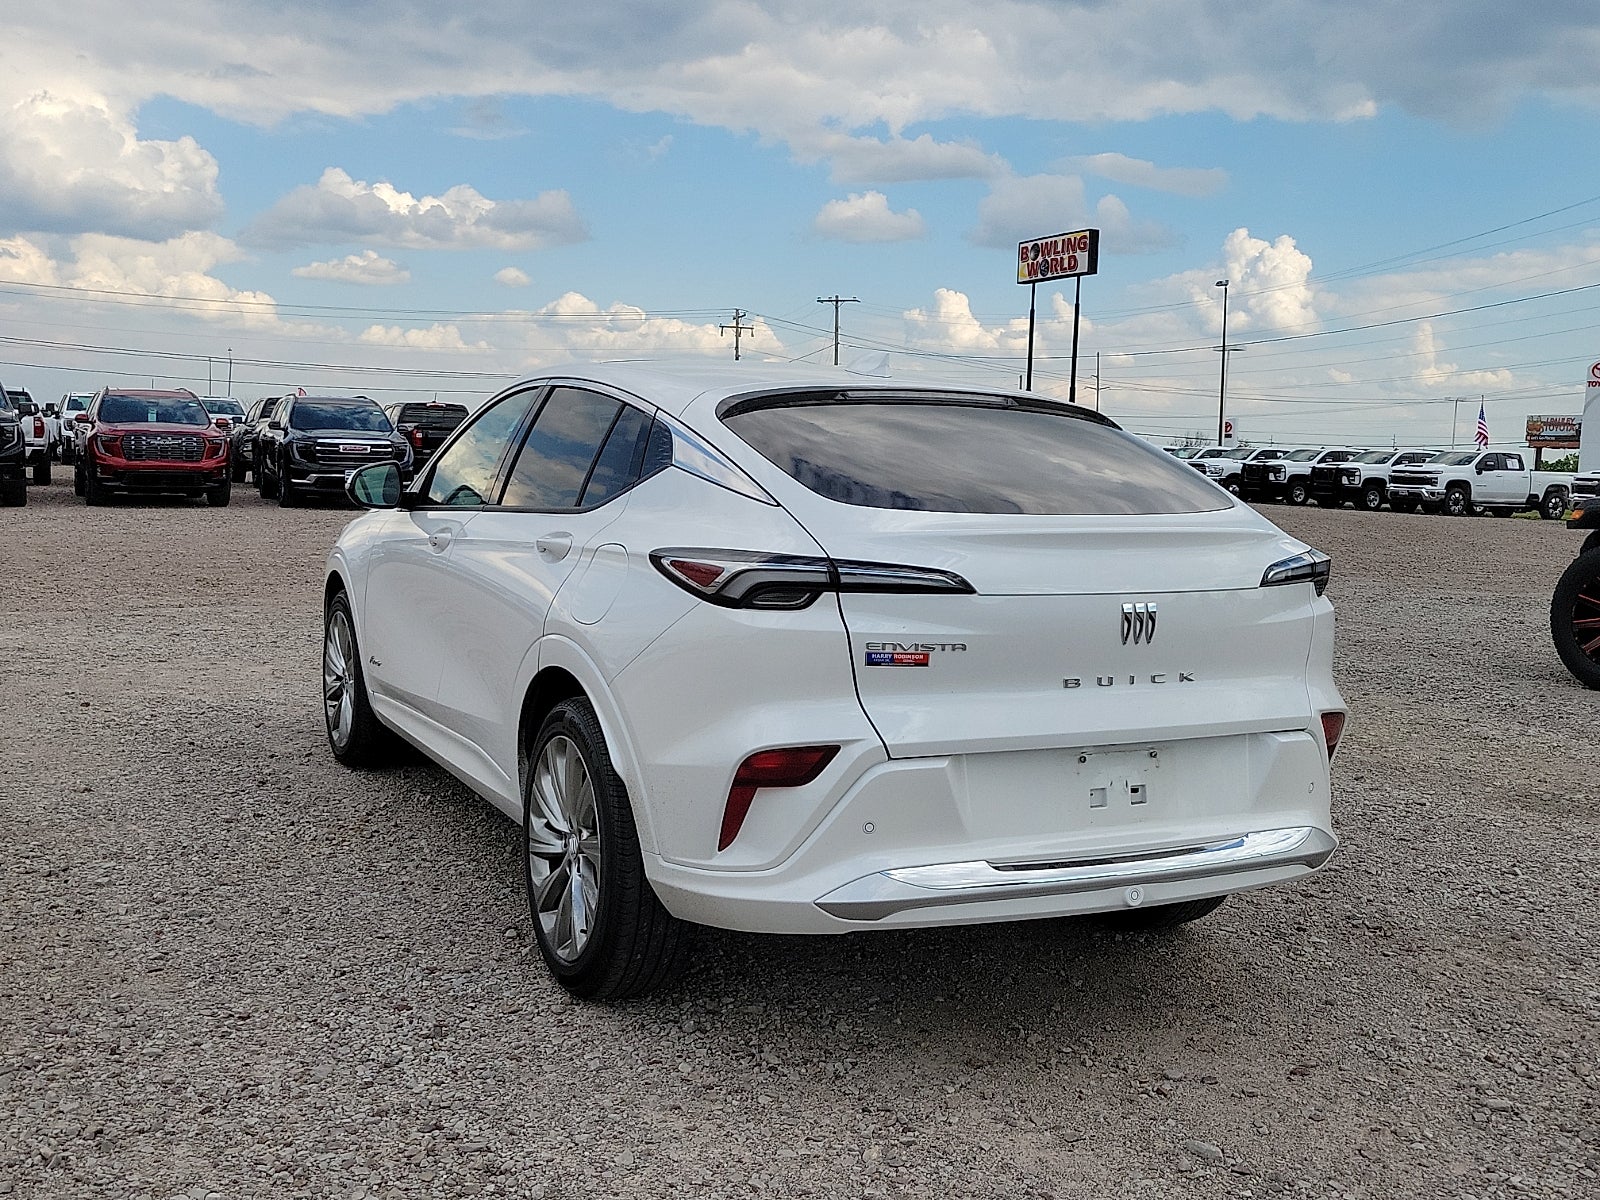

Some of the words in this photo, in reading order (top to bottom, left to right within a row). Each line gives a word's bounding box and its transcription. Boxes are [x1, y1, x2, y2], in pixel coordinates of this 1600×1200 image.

[1020, 234, 1088, 263] BOWLING
[1026, 254, 1079, 278] WORLD
[865, 642, 967, 652] ENVISTA
[1063, 672, 1195, 688] BUICK
